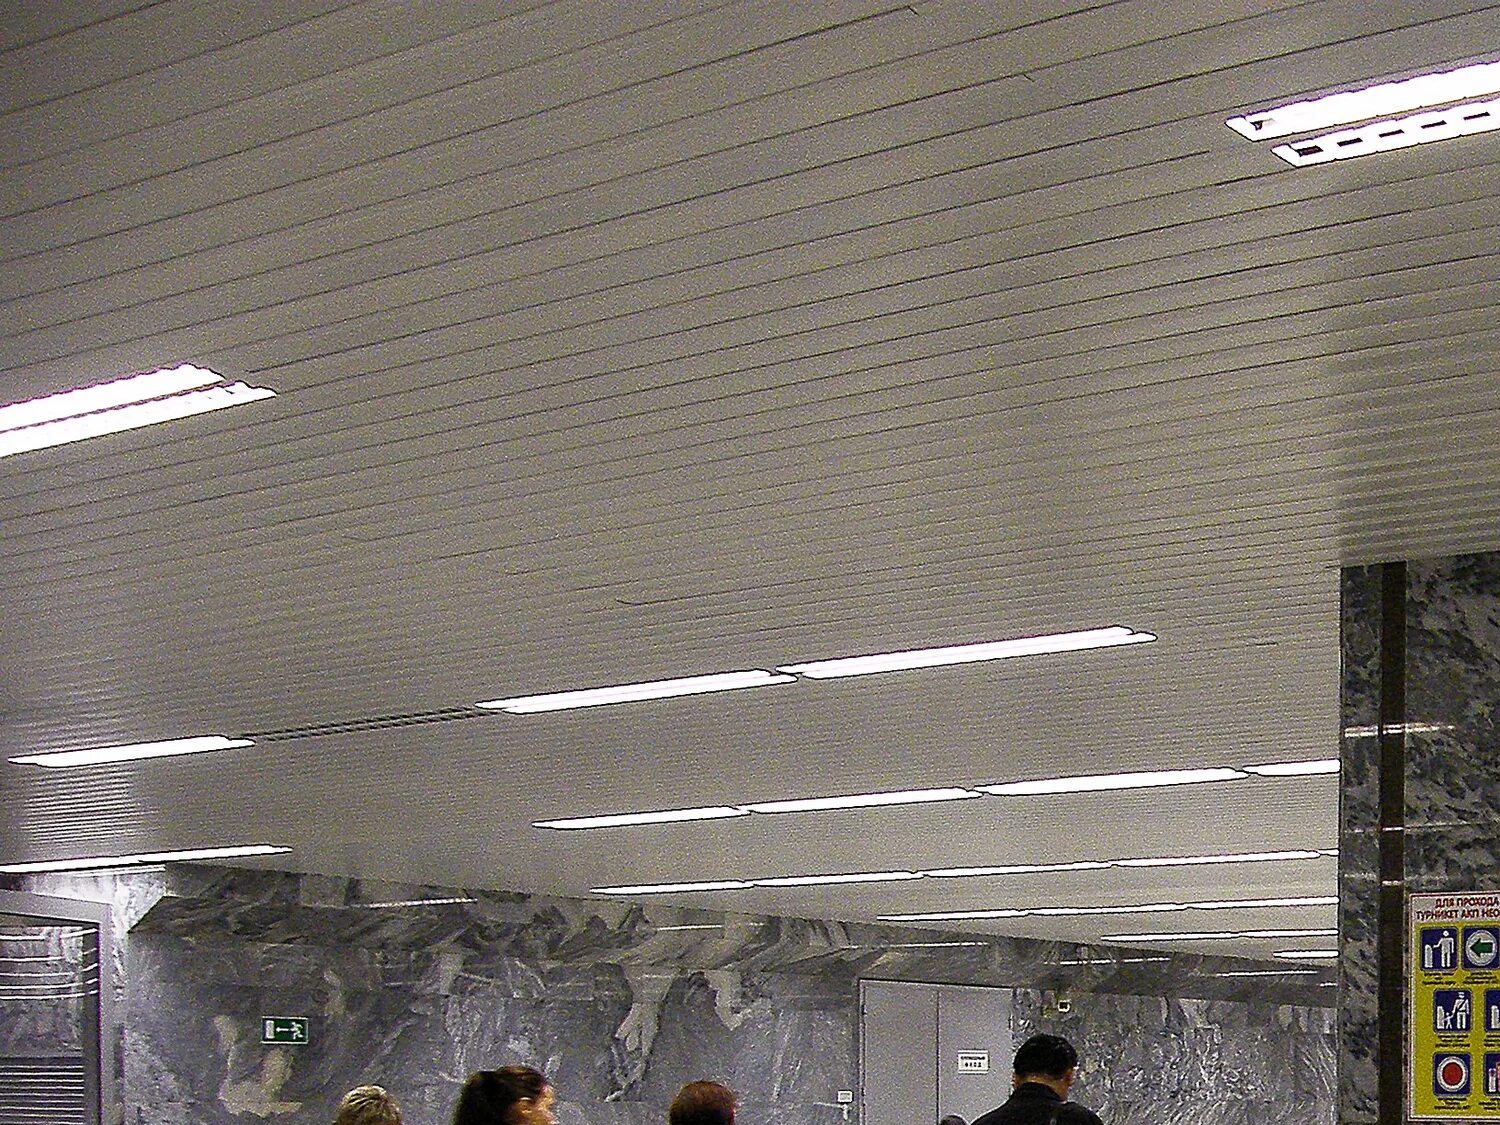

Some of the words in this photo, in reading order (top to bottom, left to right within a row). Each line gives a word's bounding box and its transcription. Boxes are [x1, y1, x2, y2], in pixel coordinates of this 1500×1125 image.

[1435, 898, 1455, 909] ДЛЯ
[1457, 896, 1499, 908] ПРОХОДА
[1416, 909, 1459, 921] ТУРНИКЕТ
[1461, 908, 1479, 919] АКП
